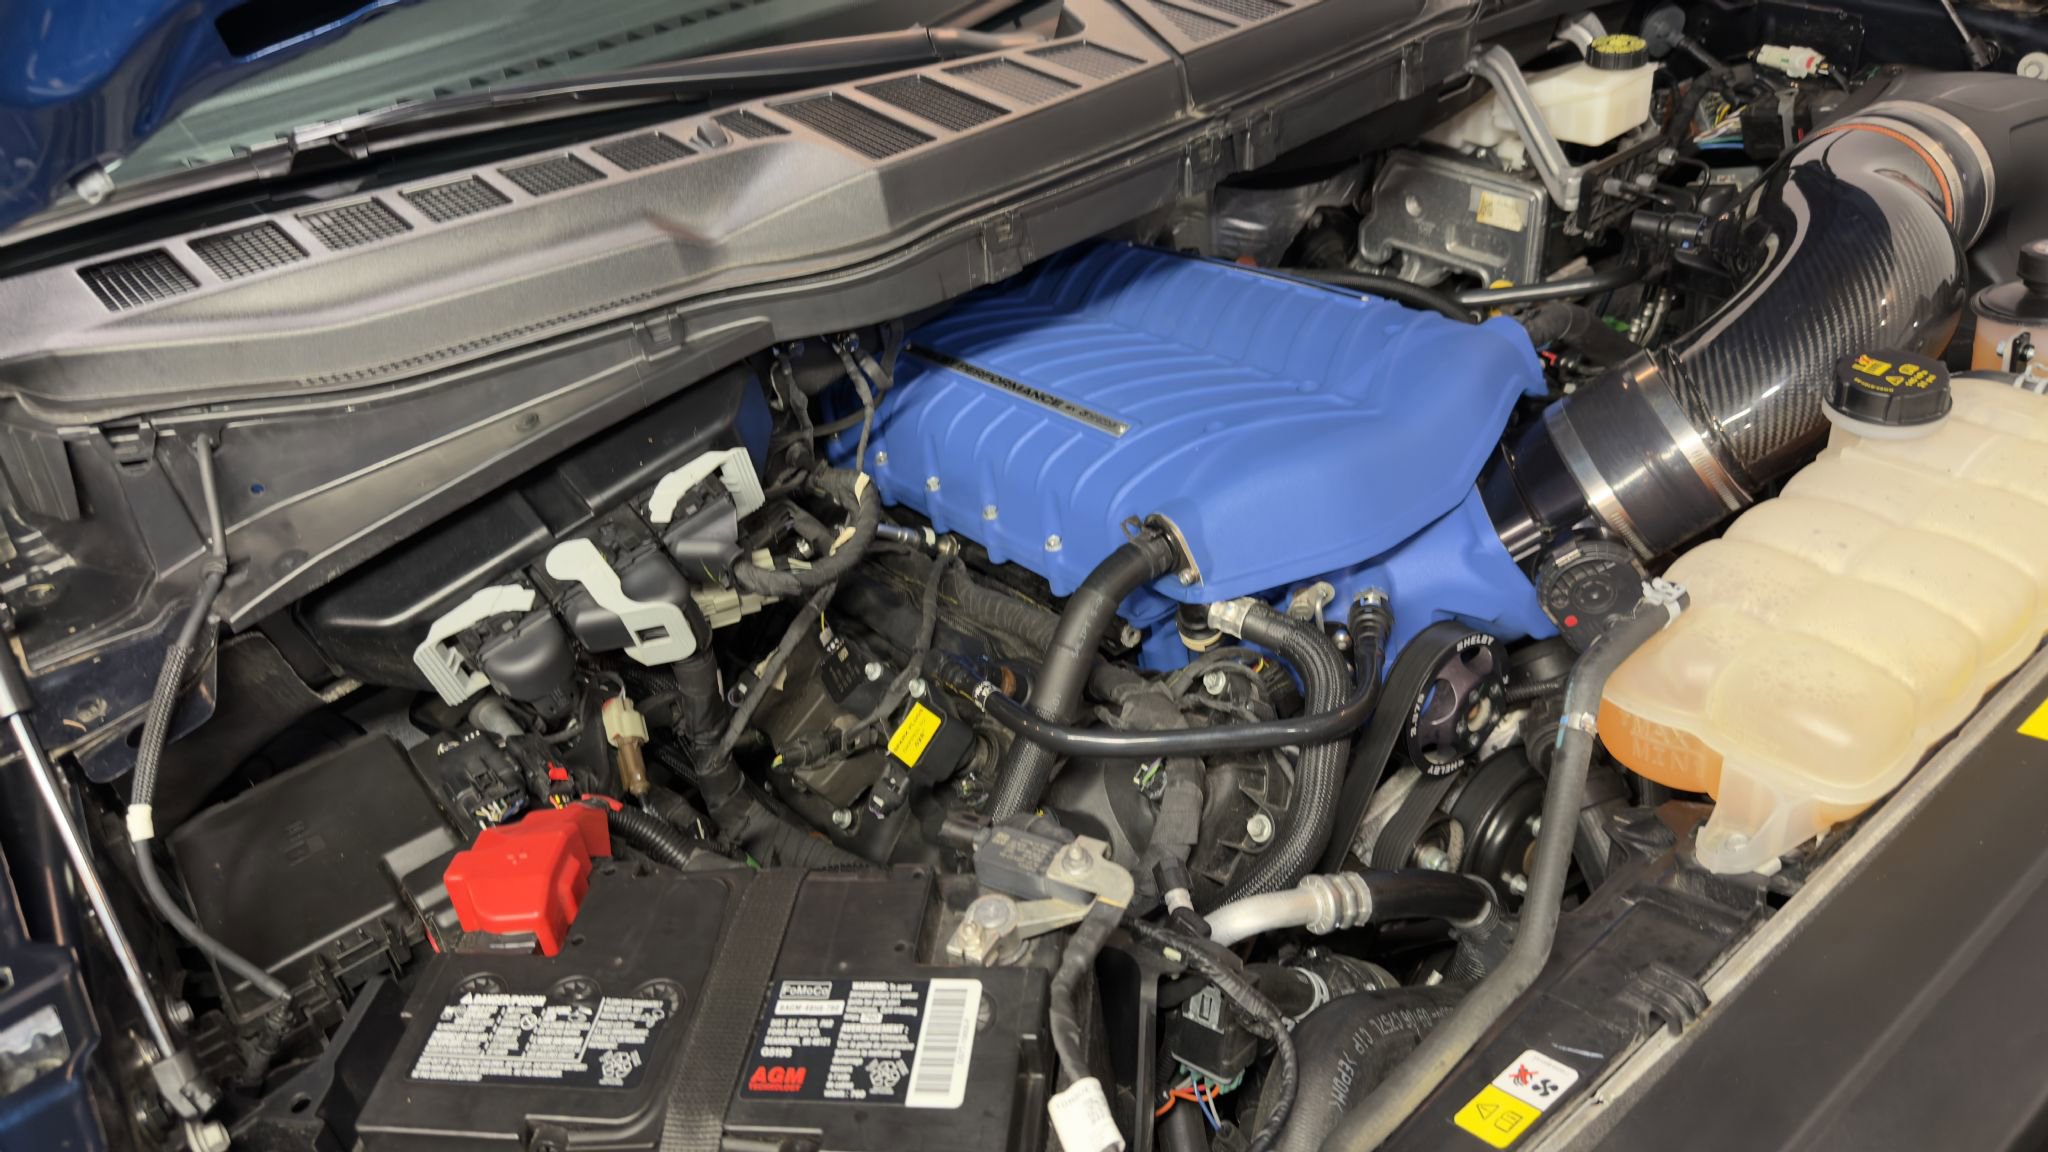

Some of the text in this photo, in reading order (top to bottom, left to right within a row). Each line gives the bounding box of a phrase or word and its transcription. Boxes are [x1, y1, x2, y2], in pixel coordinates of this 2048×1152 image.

[956, 360, 1065, 409] PERFORMANCE
[1457, 634, 1494, 652] SHELBY
[1632, 736, 1688, 772] MIN
[1427, 758, 1465, 776] SHELBY
[782, 984, 830, 997] FoMoCo
[750, 1065, 807, 1084] AGM
